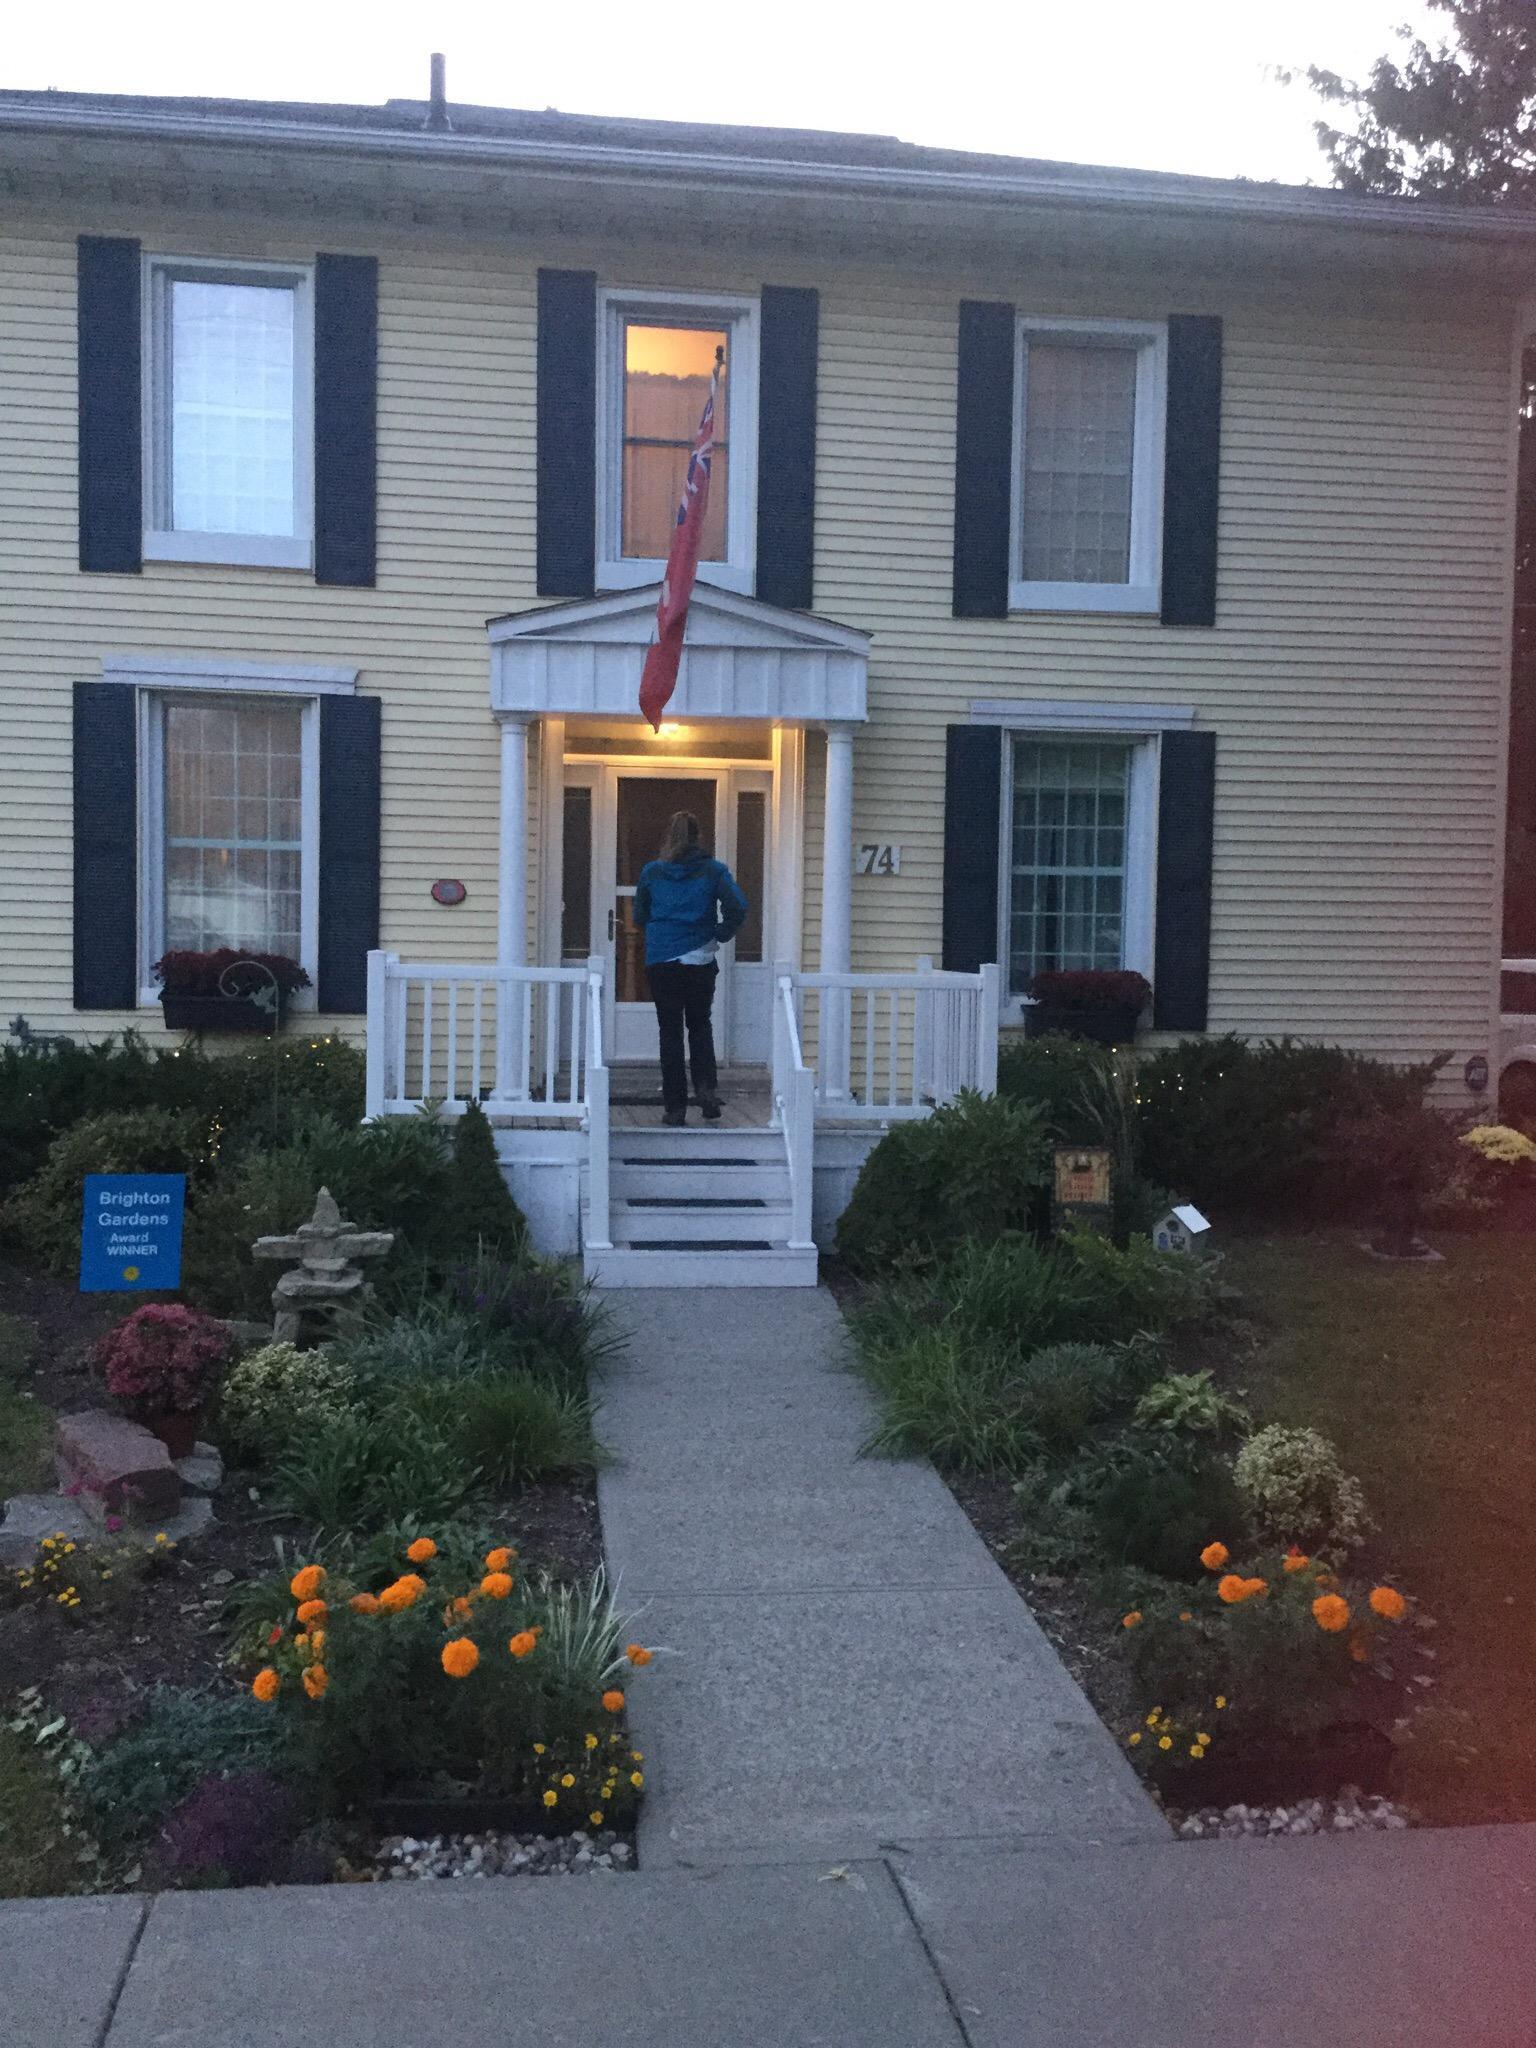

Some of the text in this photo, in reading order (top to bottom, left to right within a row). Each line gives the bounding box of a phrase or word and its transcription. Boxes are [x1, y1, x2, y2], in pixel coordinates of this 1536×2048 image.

[861, 844, 894, 875] 74
[100, 1191, 170, 1207] Brighton
[98, 1211, 169, 1226] Gardens
[110, 1232, 149, 1243] Award
[106, 1244, 158, 1256] WINNER
